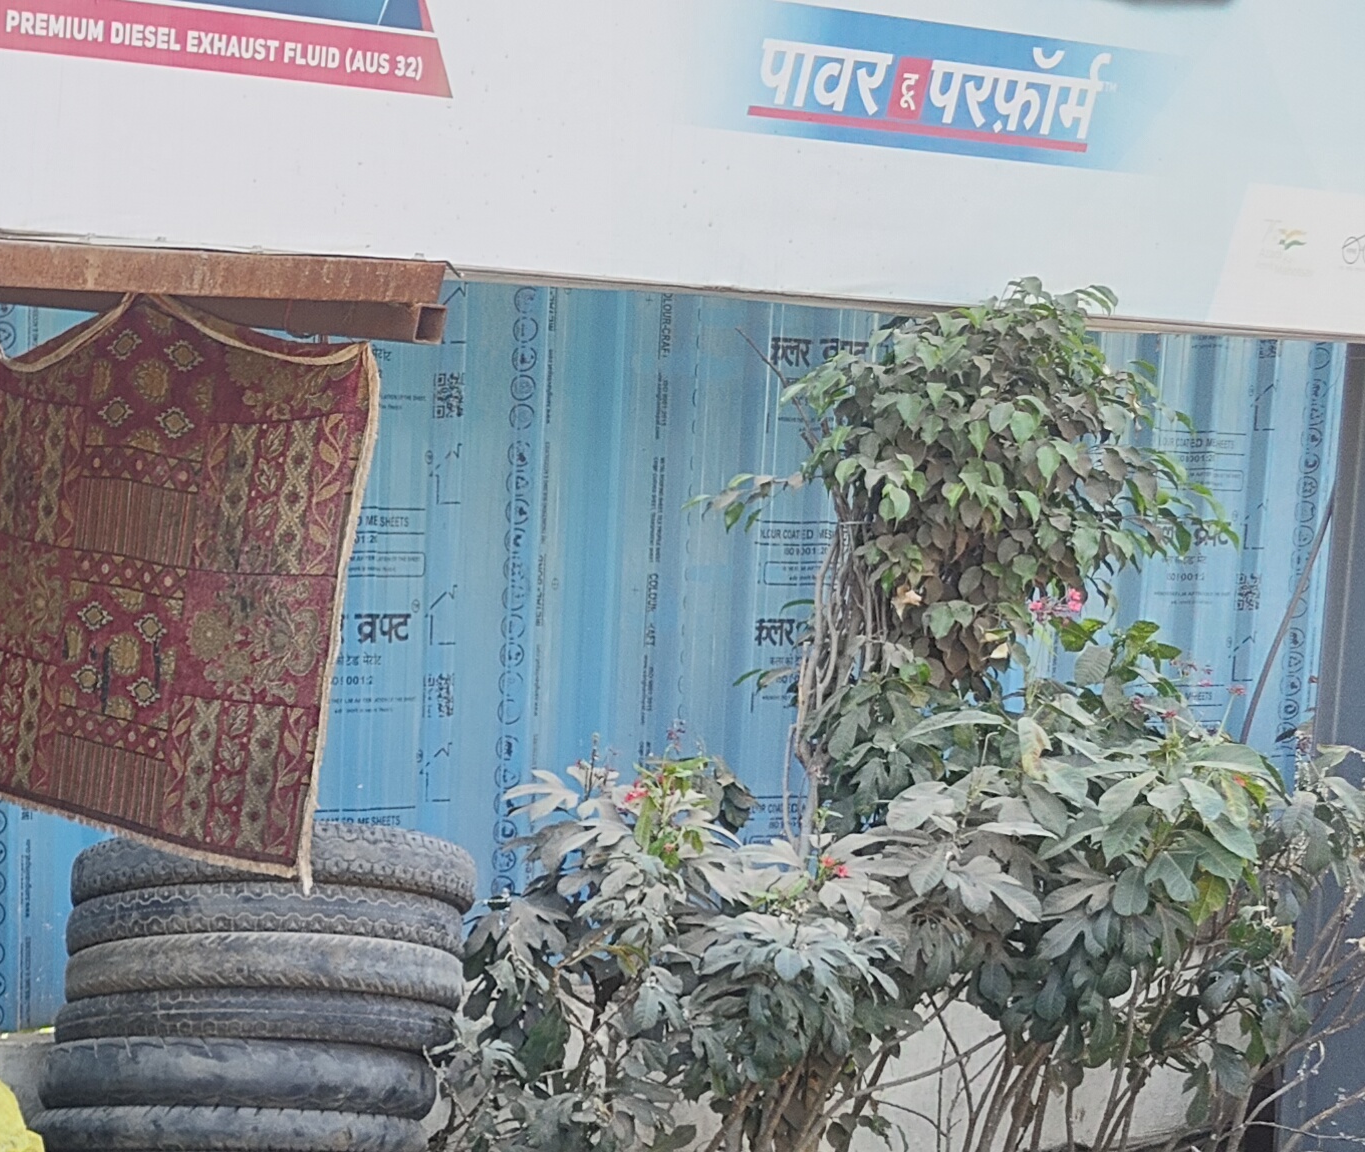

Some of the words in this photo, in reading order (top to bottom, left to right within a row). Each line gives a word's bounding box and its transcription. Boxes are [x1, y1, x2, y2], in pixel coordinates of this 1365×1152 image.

[5, 10, 104, 42] PREMIUM
[110, 24, 181, 51] DIESEL
[186, 31, 280, 62] EXHAUST
[283, 42, 340, 69] FLUID
[345, 48, 390, 75] (AUS
[395, 55, 423, 81] 32)
[760, 38, 893, 116] पावर
[899, 72, 920, 111] टू
